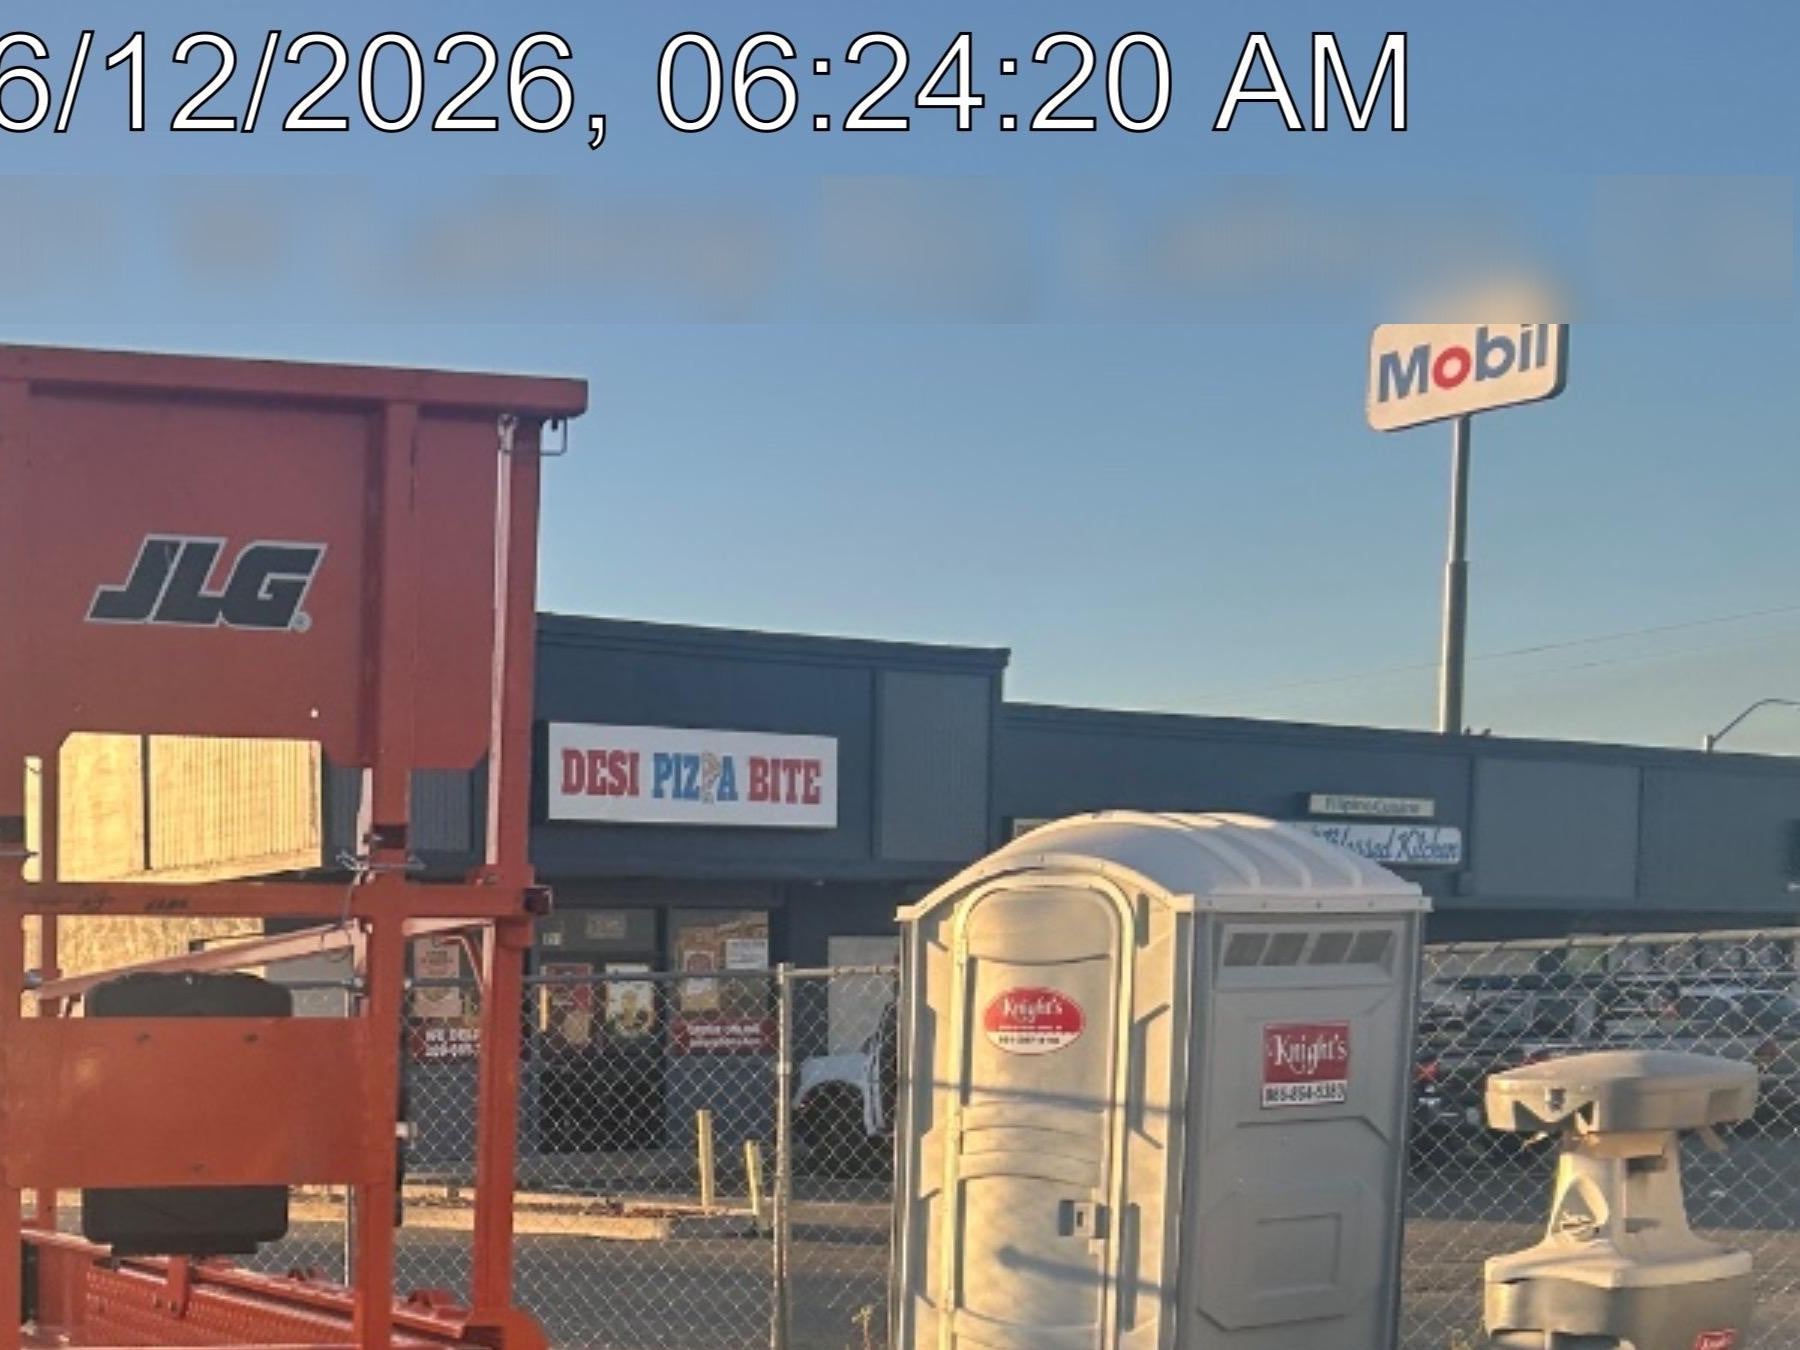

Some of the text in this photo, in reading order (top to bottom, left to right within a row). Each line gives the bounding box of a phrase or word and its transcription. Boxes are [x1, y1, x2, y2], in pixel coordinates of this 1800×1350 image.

[1377, 324, 1550, 403] Mobil
[84, 533, 328, 632] JLG
[560, 748, 821, 805] DESI PIZA BITE
[1272, 1033, 1348, 1075] Knight's
